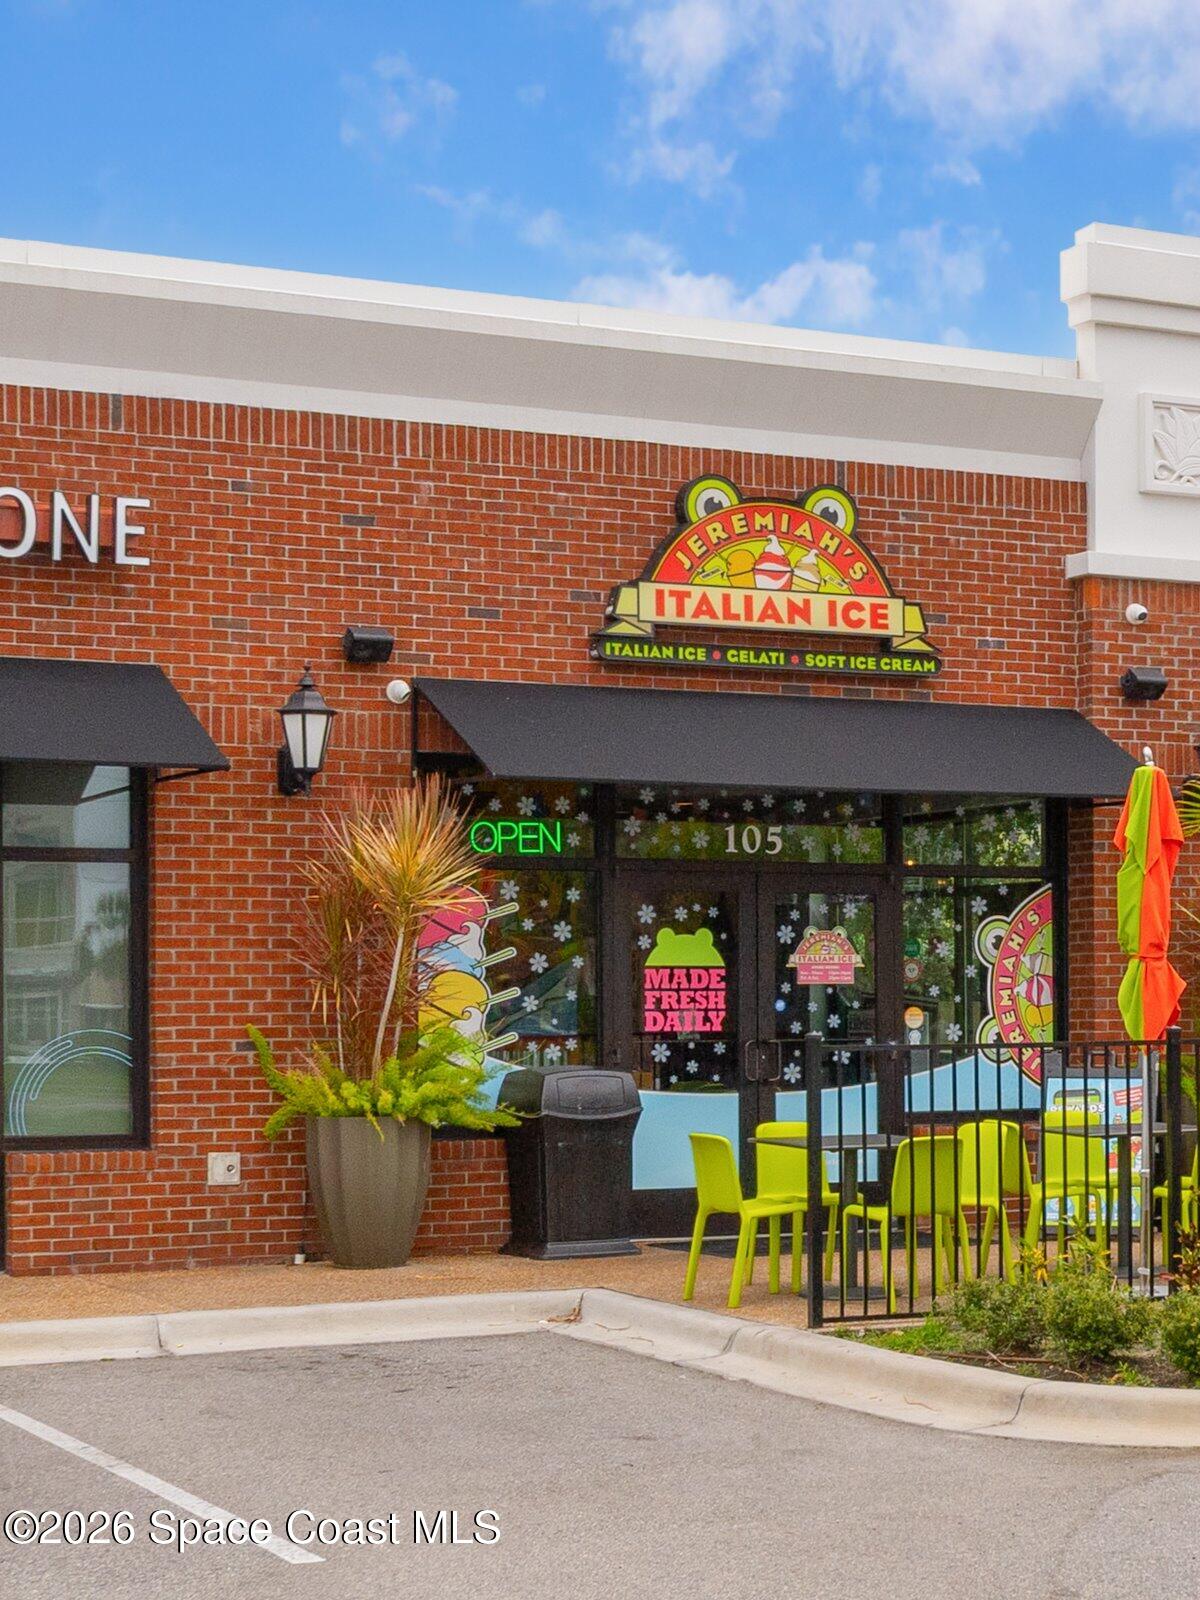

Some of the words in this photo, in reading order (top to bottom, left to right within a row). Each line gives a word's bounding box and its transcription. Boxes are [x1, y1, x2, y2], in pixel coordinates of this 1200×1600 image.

[0, 486, 151, 566] ONE
[673, 510, 871, 583] JEREMIAH'S
[654, 588, 813, 627] ITALIAN
[827, 600, 890, 630] ICE
[604, 641, 674, 659] ITALIAN
[678, 647, 707, 661] ICE
[726, 649, 785, 665] GELATI
[804, 653, 847, 669] SOFT
[849, 656, 877, 670] ICE
[879, 657, 936, 673] CREAM
[469, 820, 563, 854] OPEN
[723, 824, 783, 855] 105
[798, 954, 834, 963] ITALIAN
[837, 954, 853, 963] ICE
[644, 968, 726, 989] MADE
[644, 990, 726, 1010] FRESH
[644, 1011, 726, 1032] DAILY
